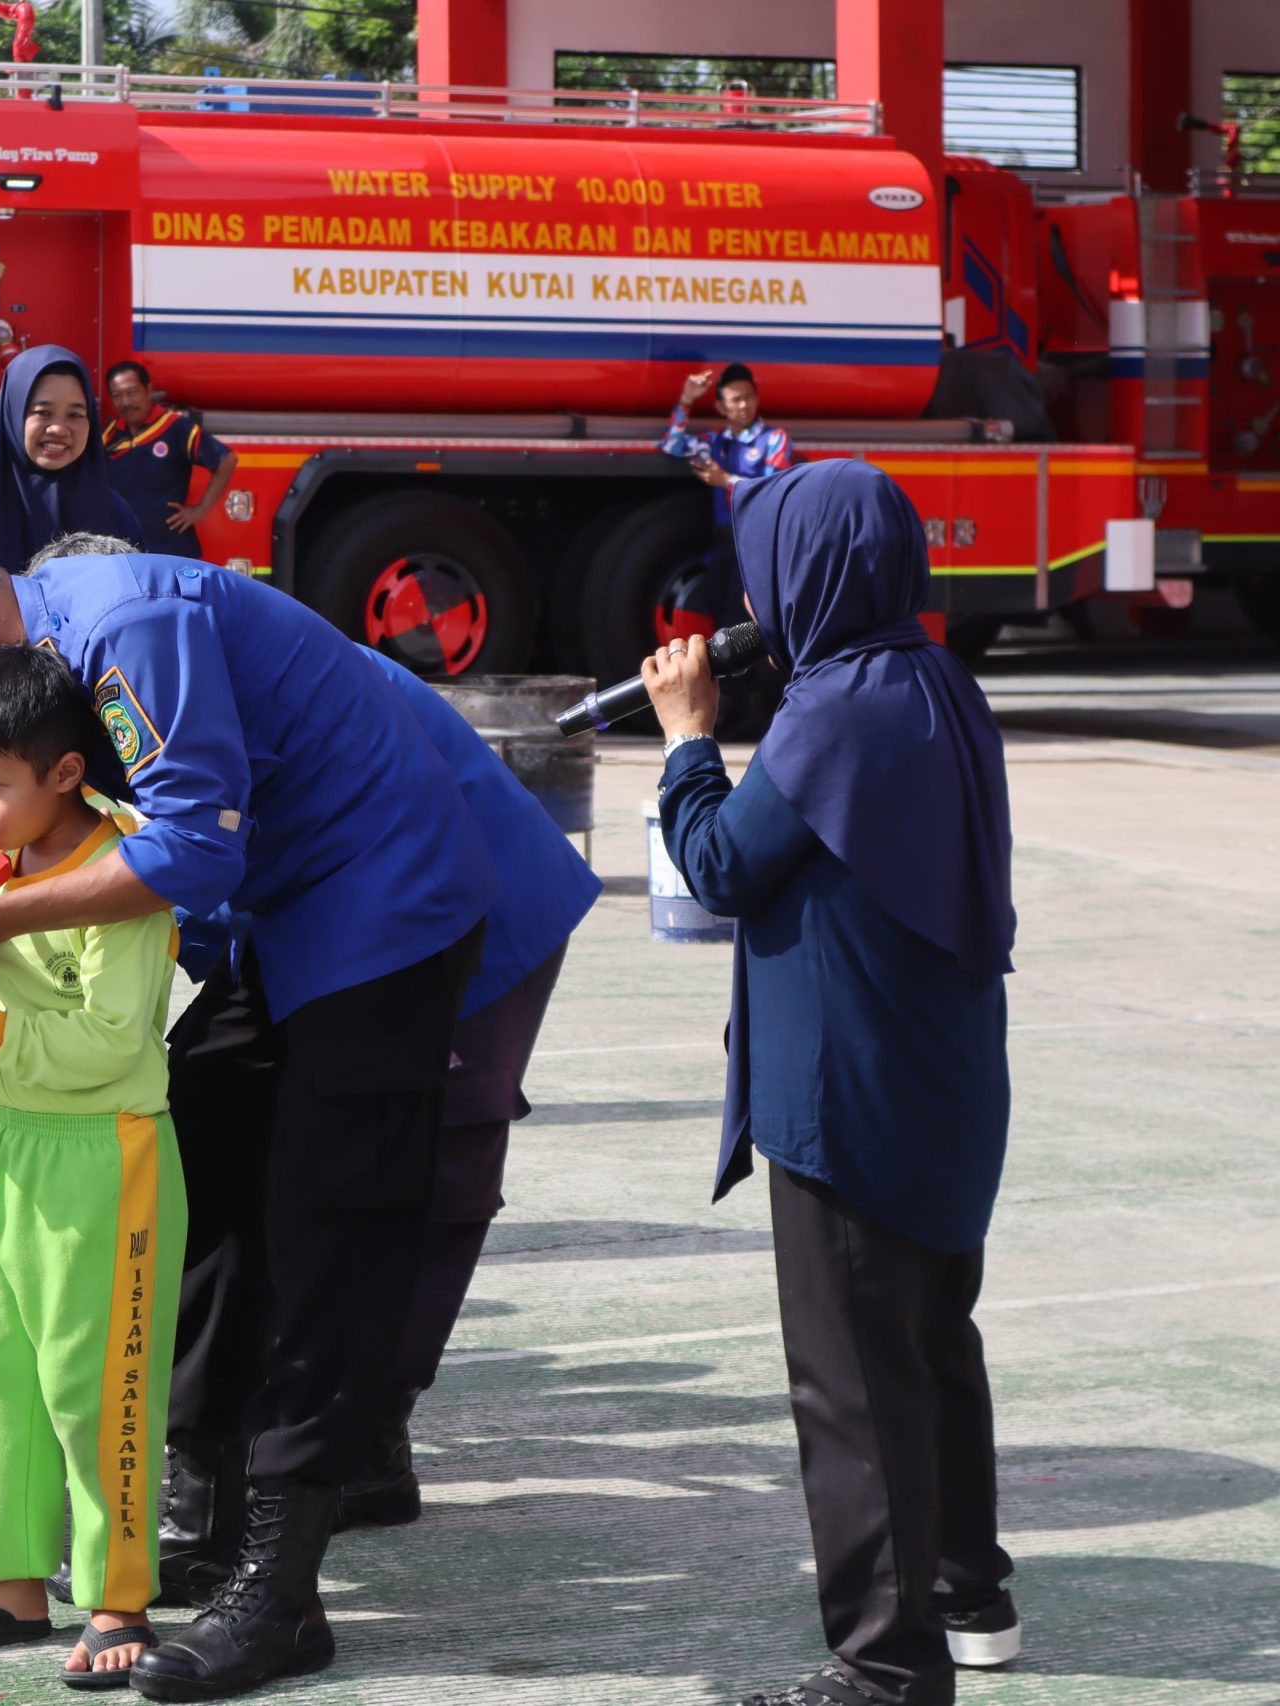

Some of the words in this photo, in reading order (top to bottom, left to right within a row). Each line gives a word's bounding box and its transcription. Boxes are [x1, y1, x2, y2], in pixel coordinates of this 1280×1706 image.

[20, 147, 54, 161] Fire
[54, 148, 99, 165] Pump
[328, 169, 431, 198] WATER
[450, 173, 556, 202] SUPPLY
[576, 177, 665, 206] 10.000
[681, 181, 764, 208] LITER
[152, 212, 245, 243] DINAS
[263, 215, 412, 246] PEMADAM
[429, 219, 616, 251] KEBAKARAN
[633, 226, 692, 255] DAN
[708, 228, 931, 260] PENYELAMATAN
[293, 266, 469, 298] KABUPATEN
[487, 272, 574, 300] KUTAI
[592, 275, 808, 305] KARTANEGARA
[124, 1268, 143, 1358] ISLAM
[118, 1369, 139, 1541] SALSABILLA
